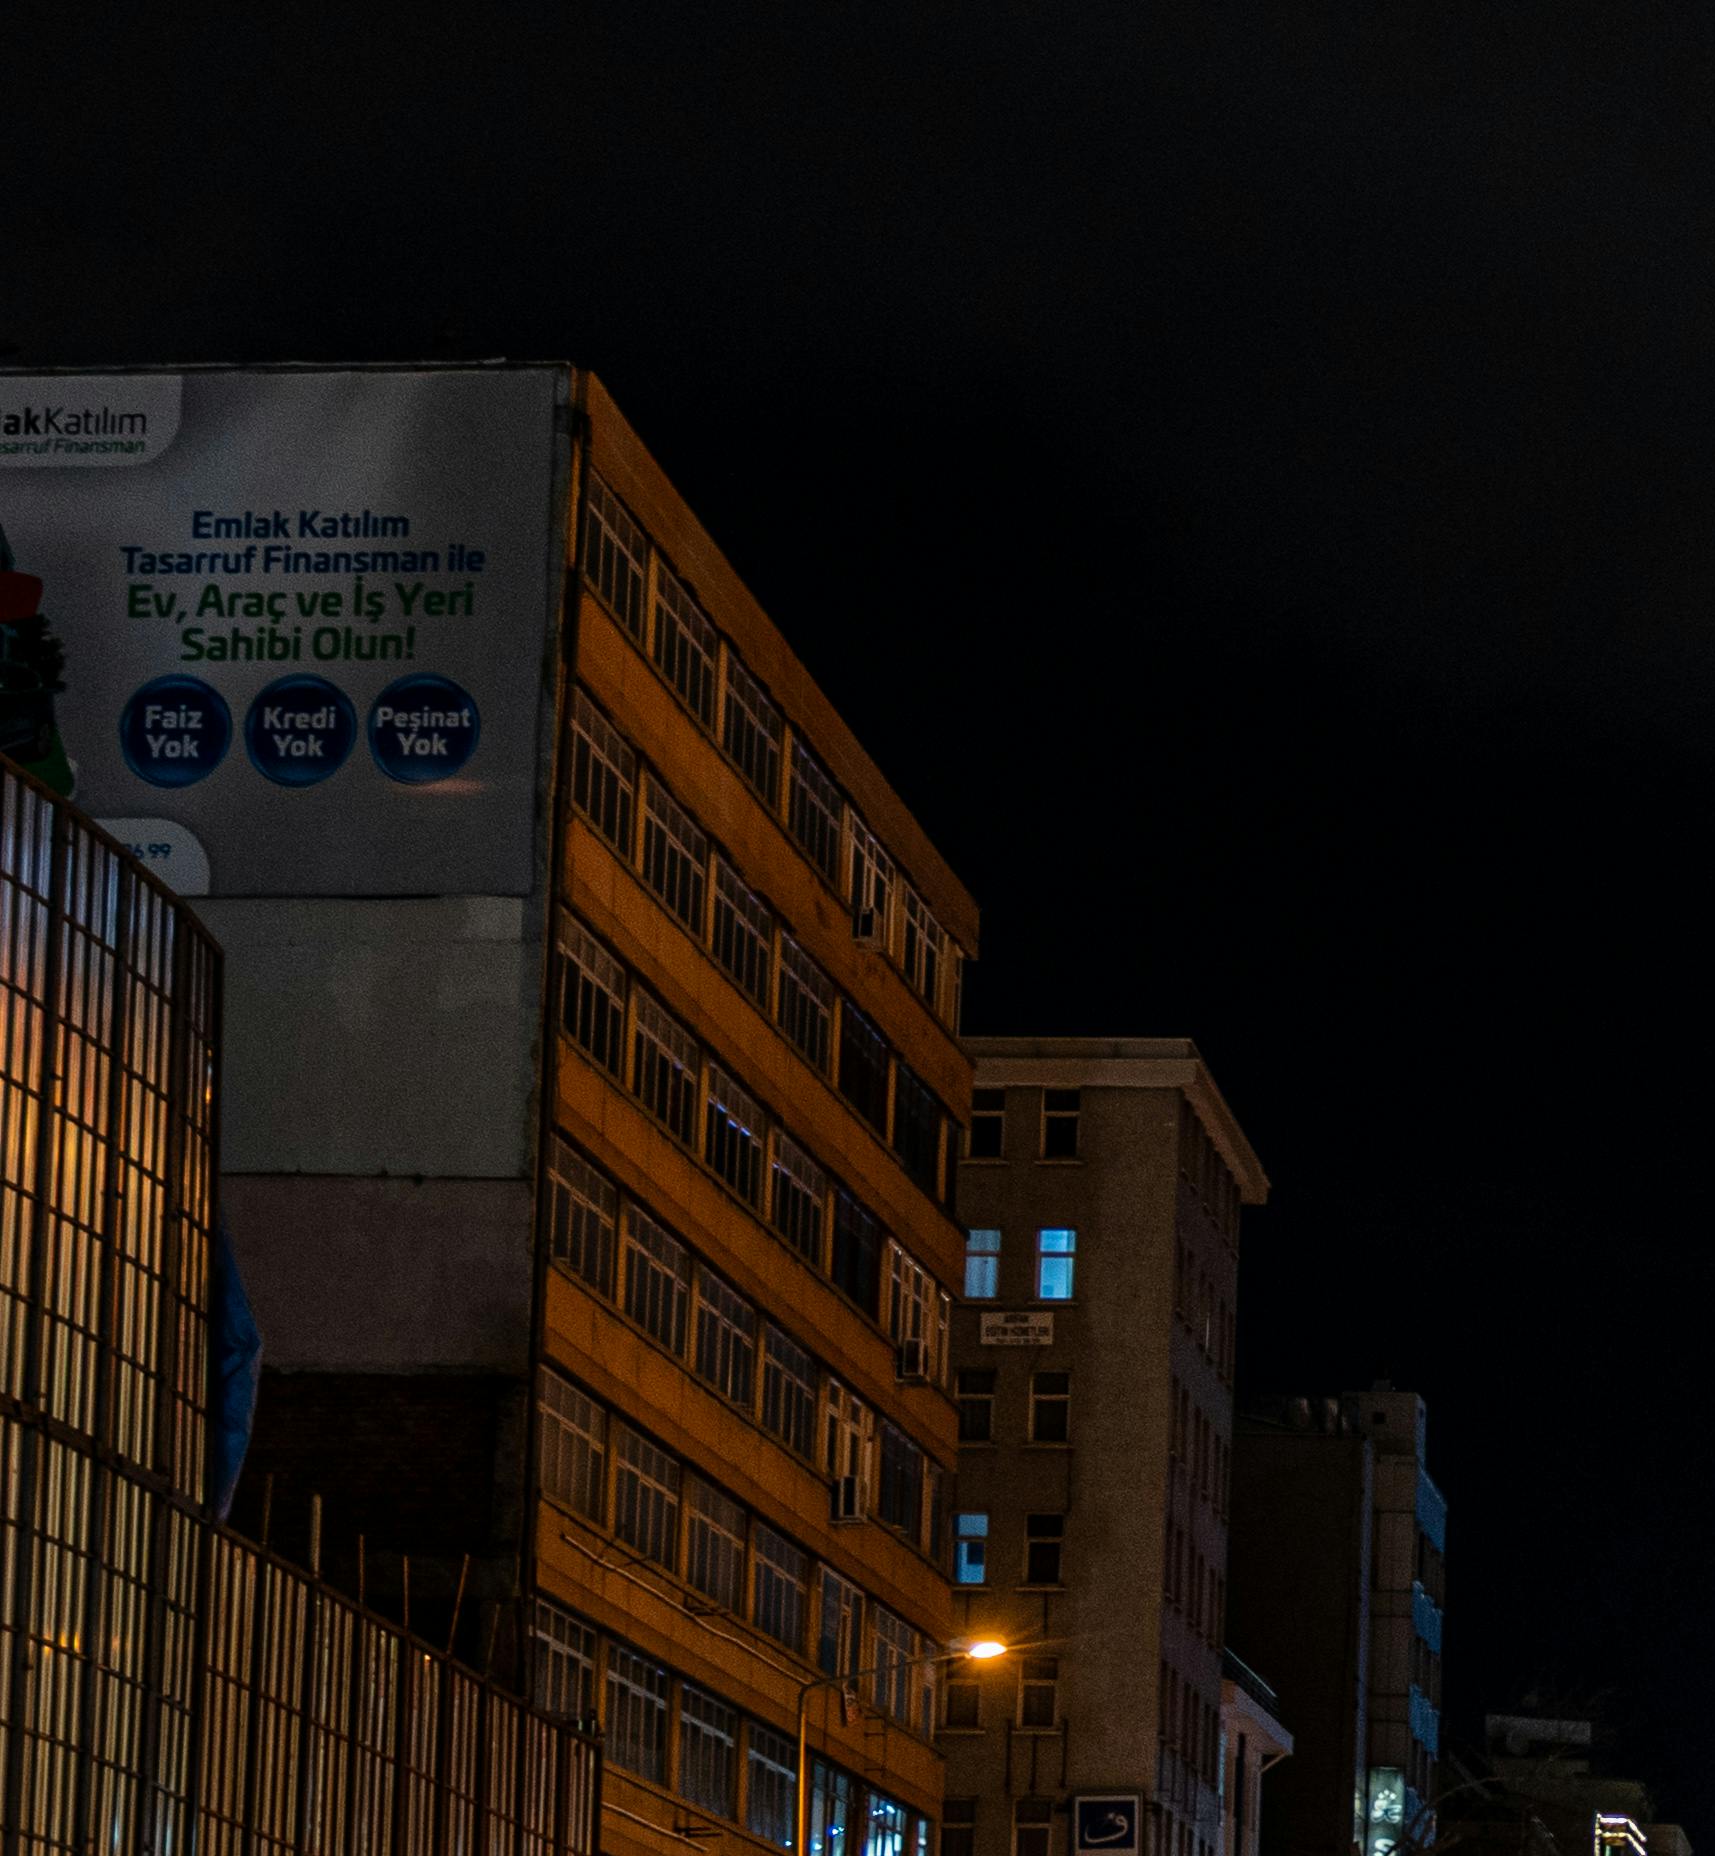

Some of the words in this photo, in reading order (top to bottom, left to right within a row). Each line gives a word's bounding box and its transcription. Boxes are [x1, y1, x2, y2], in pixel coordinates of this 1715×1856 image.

[0, 407, 147, 436] akKatılım
[54, 438, 146, 454] Finansman
[192, 511, 290, 539] Emlak
[300, 510, 410, 538] Katılım
[121, 545, 257, 575] Tasarruf
[264, 546, 439, 574] Finansman
[448, 545, 485, 573] ile
[128, 585, 187, 624] Ev,
[197, 584, 286, 624] Araç
[297, 591, 342, 617] ve
[353, 577, 384, 623] İş
[395, 582, 475, 616] Yeri
[181, 627, 302, 661] Sahibi
[313, 627, 416, 661] Olun!
[144, 706, 204, 731] Faiz
[262, 706, 337, 731] Kredi
[375, 706, 471, 734] Peşinat
[149, 734, 200, 759] Yok
[273, 733, 325, 758] Yok
[398, 733, 449, 757] Yok
